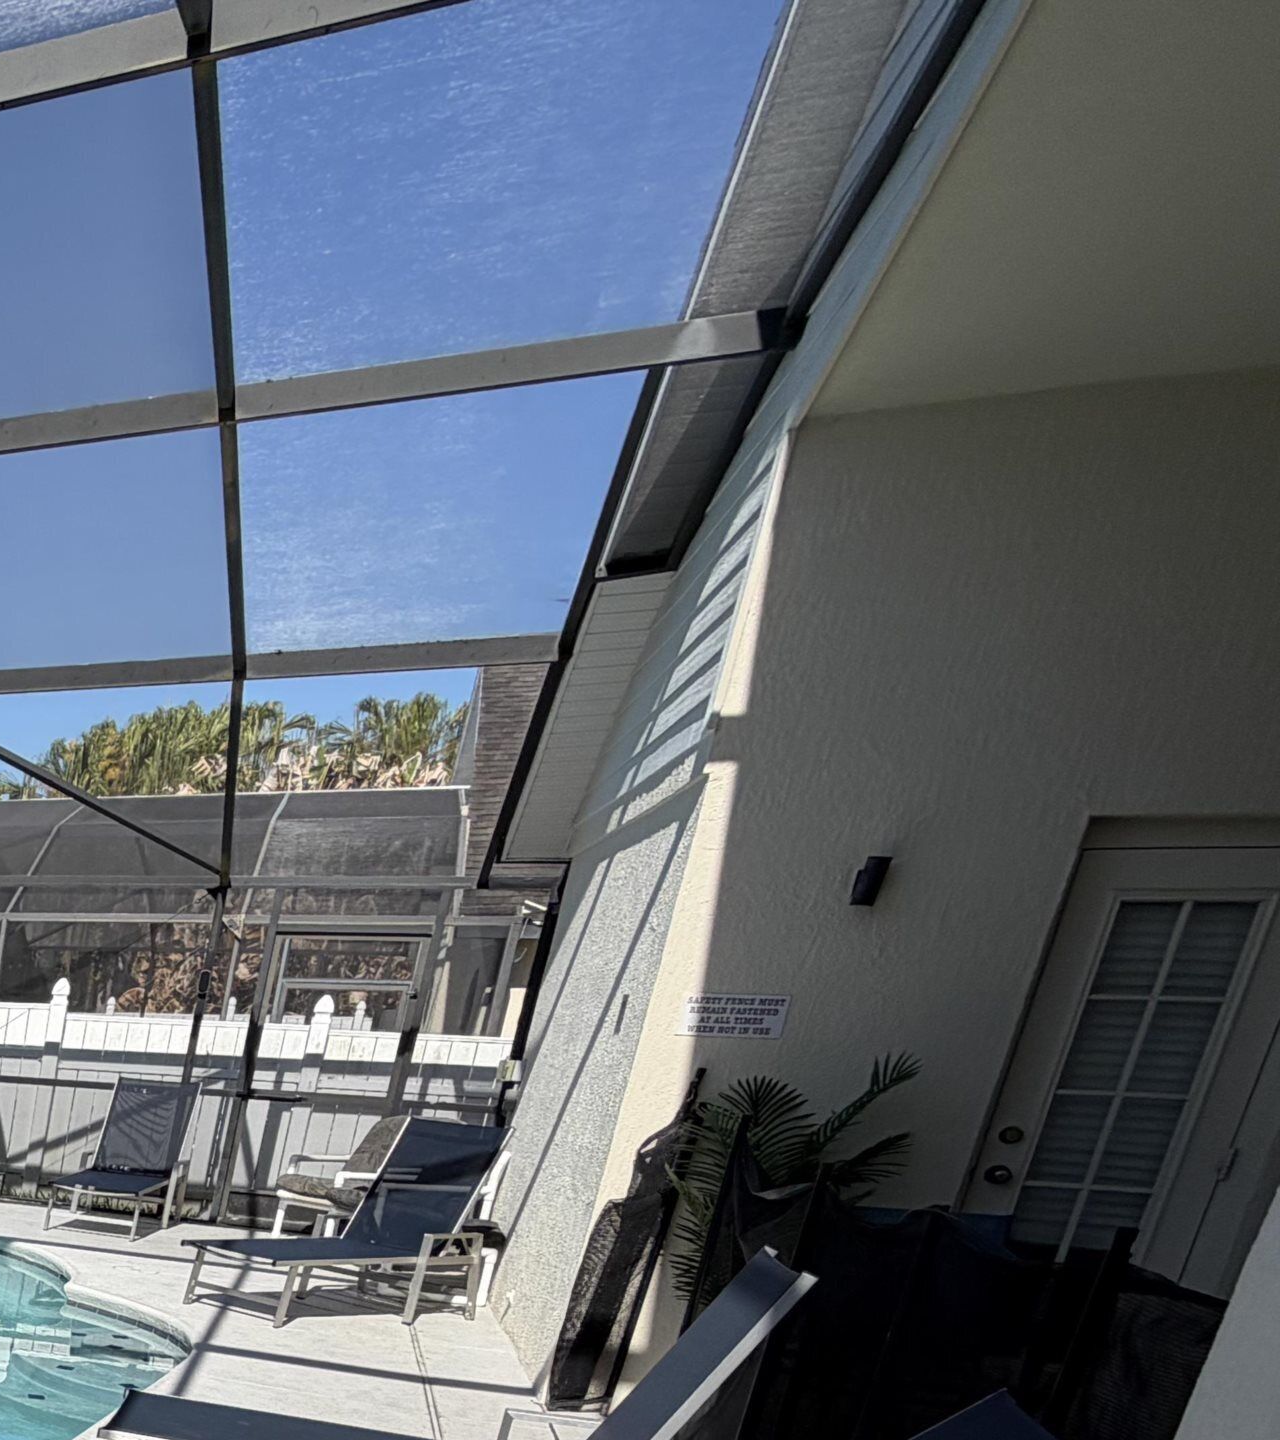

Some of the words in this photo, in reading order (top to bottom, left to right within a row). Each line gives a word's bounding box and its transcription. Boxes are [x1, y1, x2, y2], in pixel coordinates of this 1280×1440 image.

[757, 998, 786, 1007] MUST
[689, 1006, 728, 1015] REMAIN
[729, 1007, 779, 1016] FASTENED
[713, 1016, 731, 1024] ALL
[733, 1017, 764, 1025] TIMES
[717, 1026, 737, 1034] NOT
[752, 1027, 771, 1035] USE
